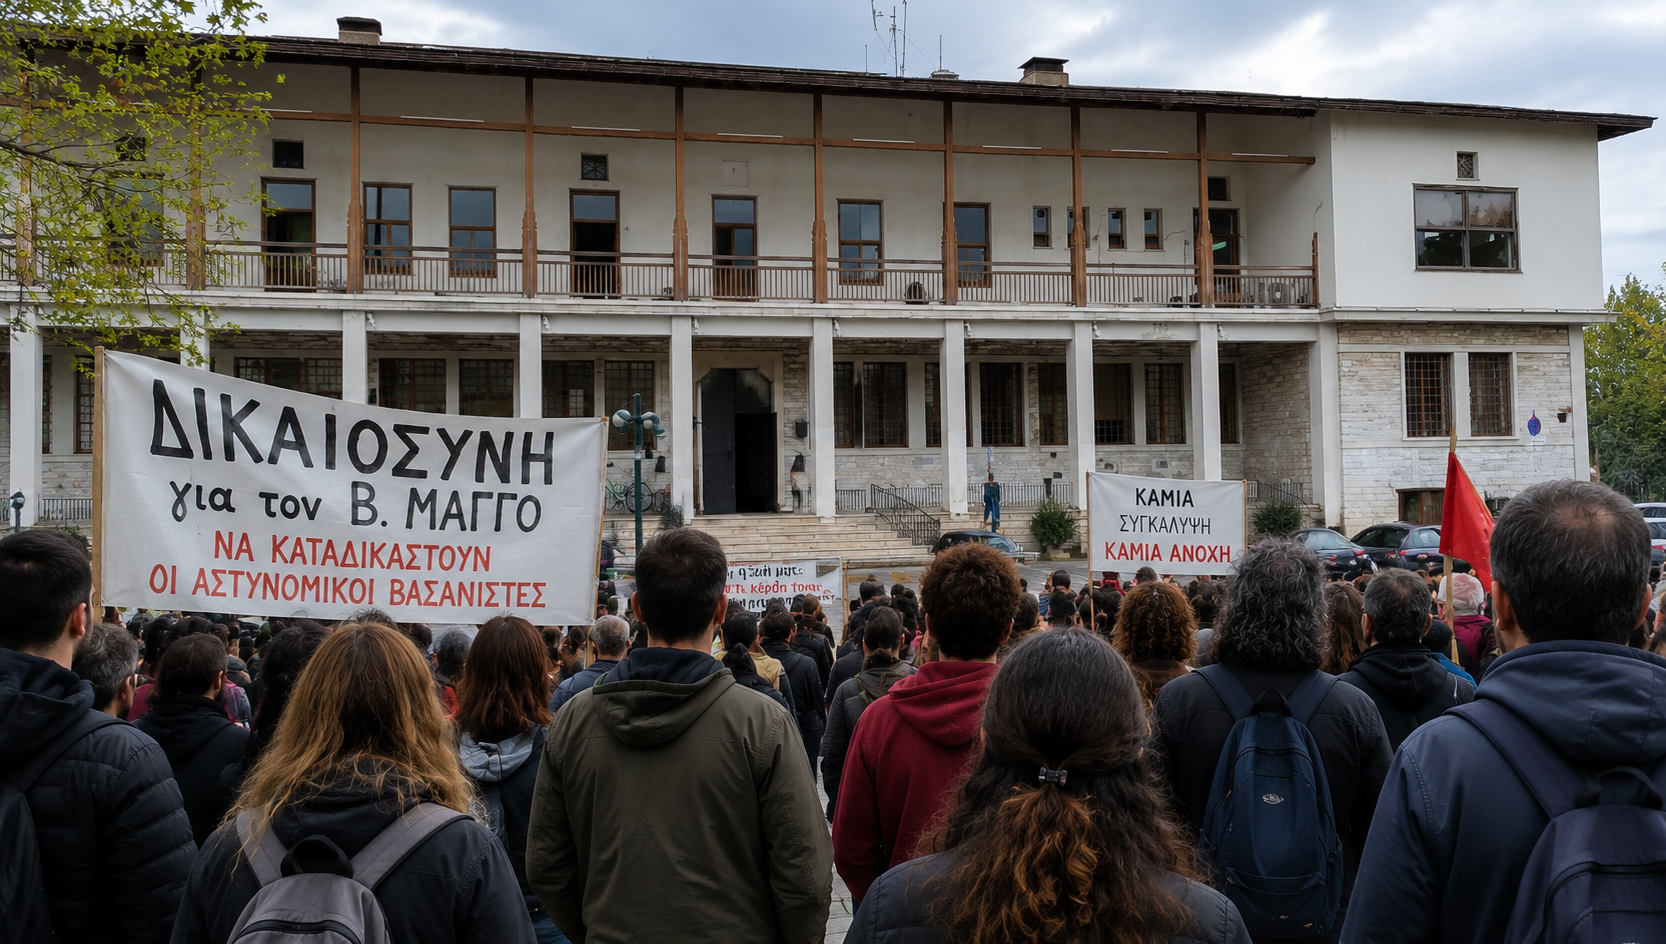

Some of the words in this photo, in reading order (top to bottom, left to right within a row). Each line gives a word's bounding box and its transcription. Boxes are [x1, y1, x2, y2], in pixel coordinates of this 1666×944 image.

[150, 379, 554, 486] ΔΙΚΑΙΟΣΥΝΗ
[169, 480, 236, 523] για
[259, 491, 323, 521] τον
[351, 481, 388, 528] Β.
[406, 488, 542, 533] ΜΑΓΓΟ
[1136, 488, 1194, 508] ΚΑΜΙΑ
[1120, 515, 1211, 535] ΣΥΓΚΑΛΥΨΗ
[215, 531, 255, 562] ΝΑ
[272, 535, 491, 572] ΚΑΤΑΔΙΚΑΣΤΟΥΝ
[1105, 541, 1162, 562] ΚΑΜΙΑ
[1169, 544, 1231, 563] ΑΝΟΧΗ
[150, 564, 177, 595] ΟΙ
[192, 569, 375, 605] ΑΣΤΥΝΟΜΙΚΟΙ
[390, 579, 547, 608] ΒΑΣΑΝΙΣΤΕΣ
